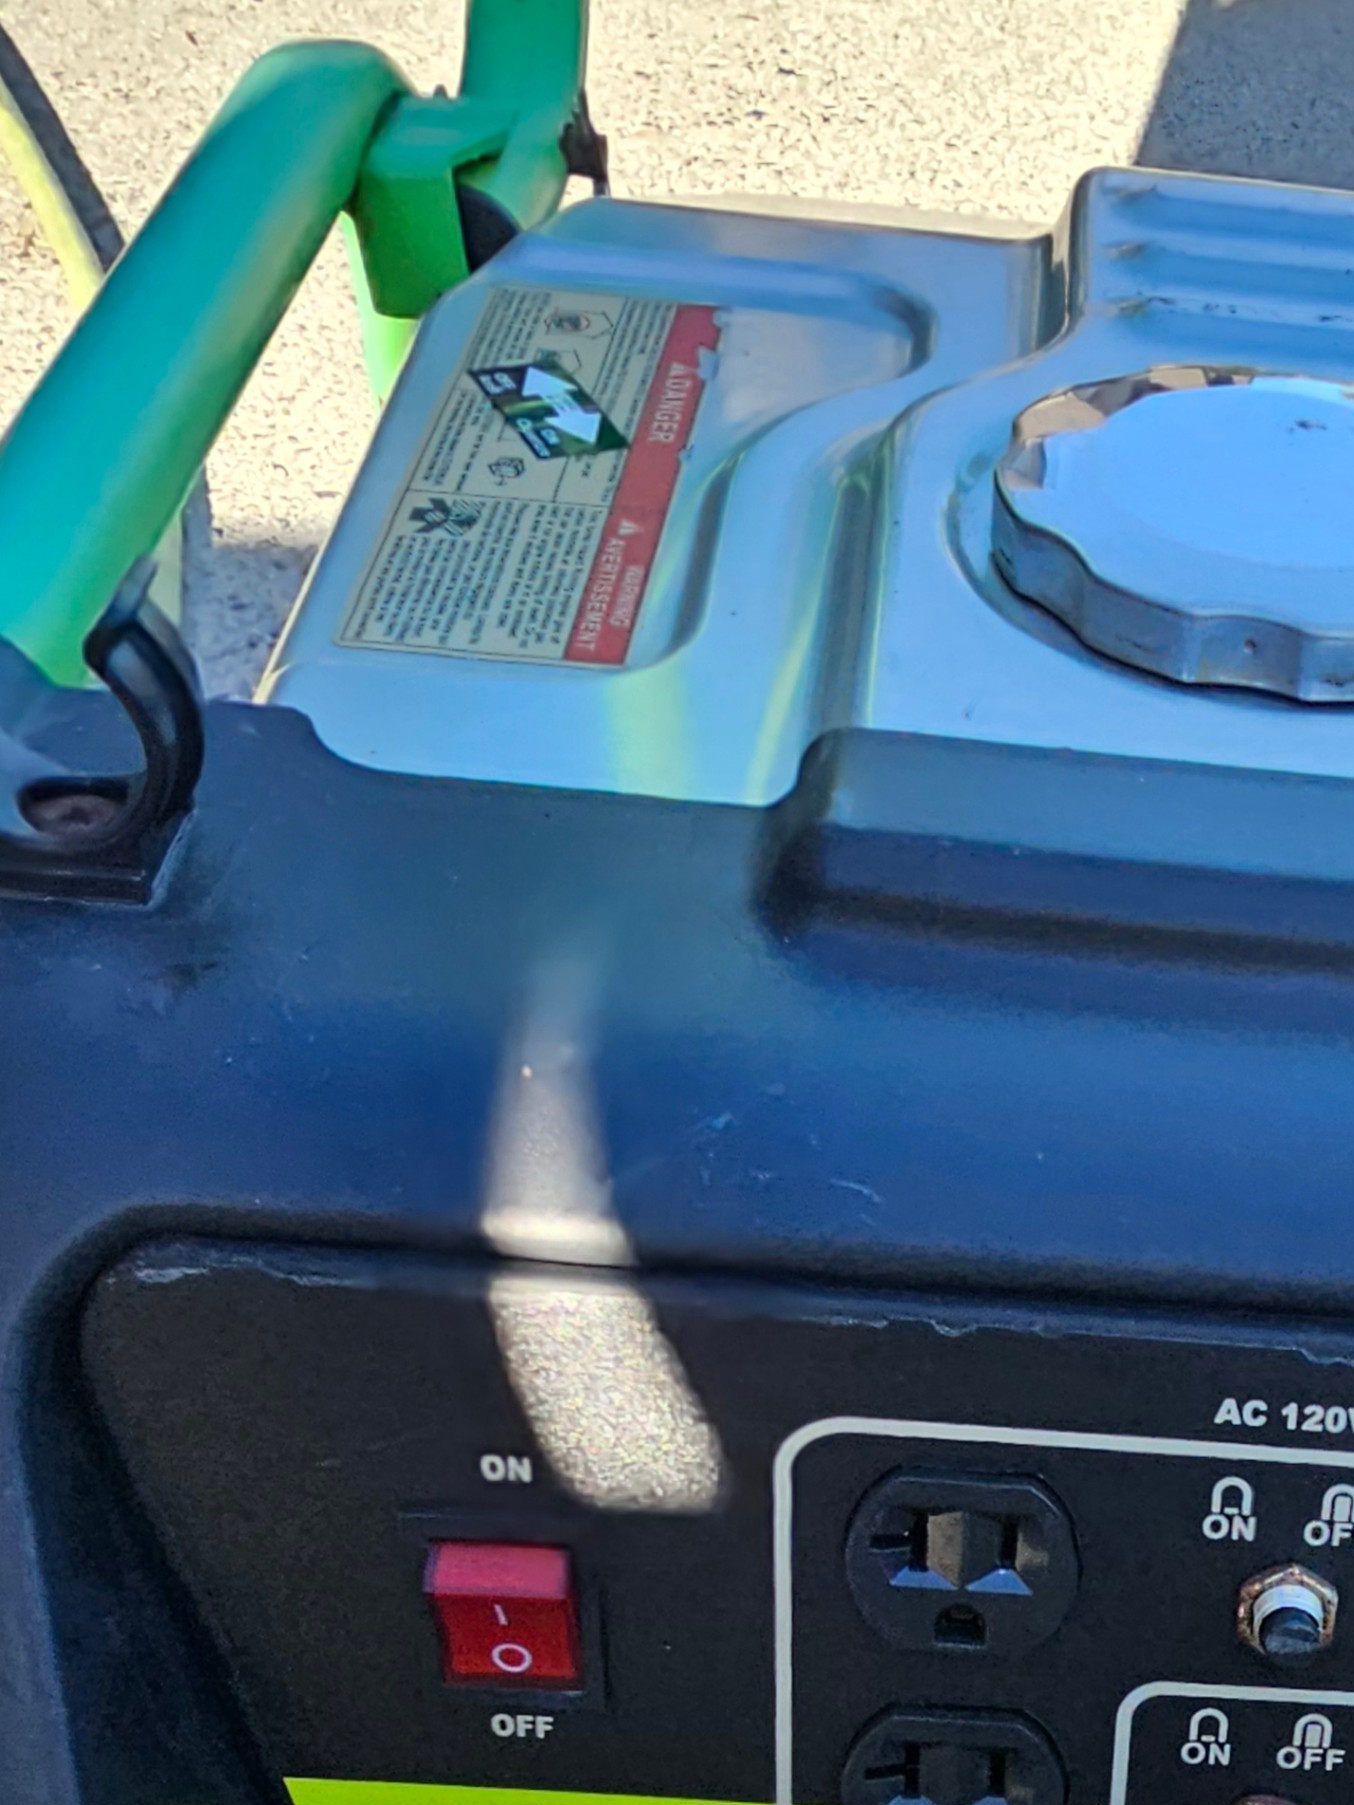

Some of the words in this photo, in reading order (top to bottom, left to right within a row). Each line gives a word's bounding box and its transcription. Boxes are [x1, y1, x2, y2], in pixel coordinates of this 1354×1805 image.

[647, 379, 692, 443] DANGER
[575, 537, 625, 652] AVERTISSEMENT
[609, 565, 646, 627] WARNING
[1213, 1397, 1268, 1427] AC
[480, 1454, 532, 1483] ON
[1202, 1514, 1257, 1542] ON
[490, 1713, 554, 1739] OFF
[1180, 1742, 1231, 1766] ON
[1276, 1746, 1346, 1771] OFF
